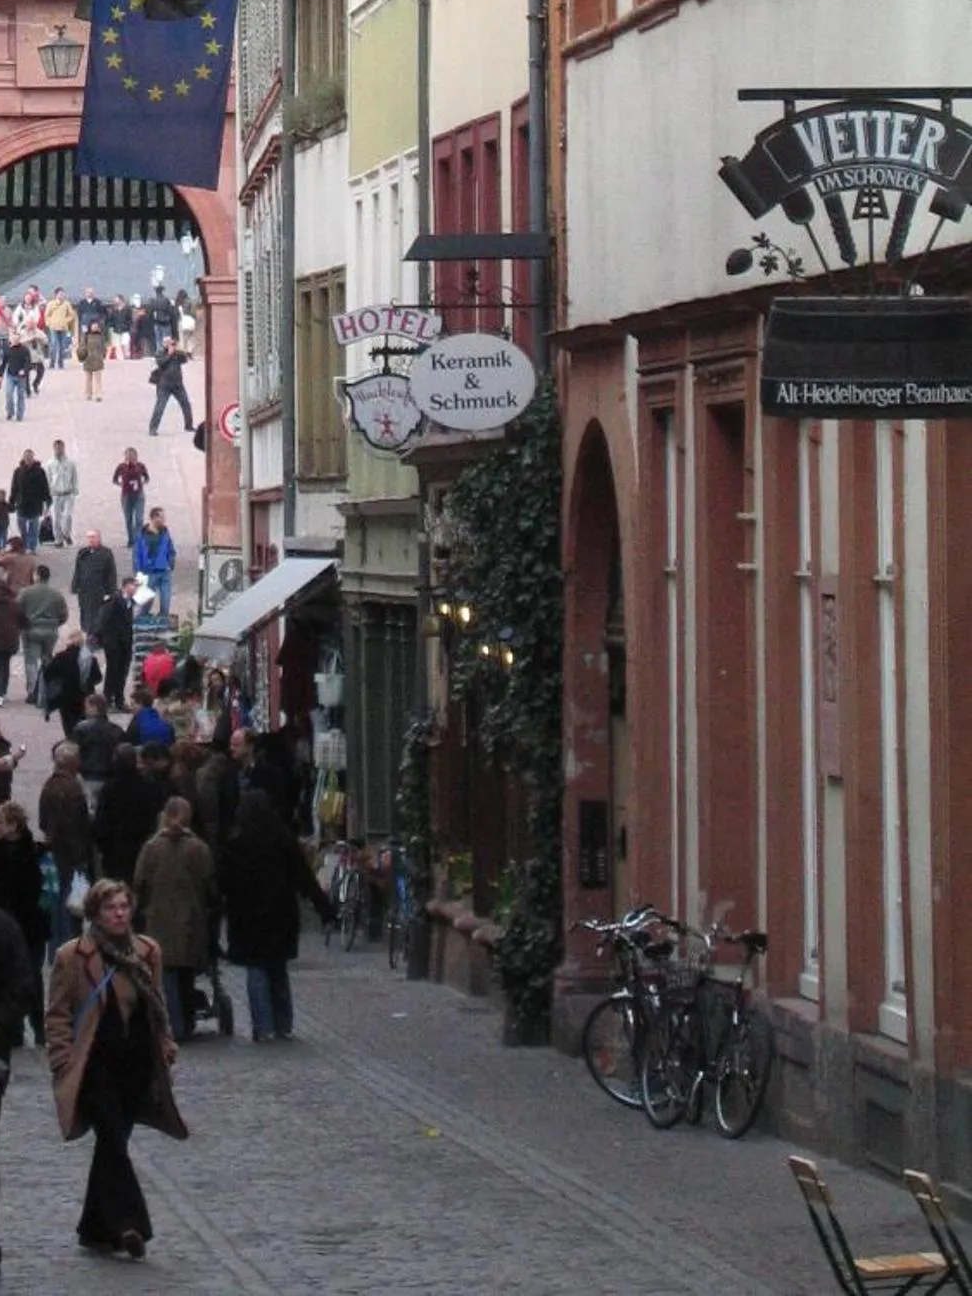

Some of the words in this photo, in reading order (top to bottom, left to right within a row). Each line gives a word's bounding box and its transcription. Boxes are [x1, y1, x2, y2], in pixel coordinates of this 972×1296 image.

[792, 110, 945, 171] VETTER
[815, 172, 842, 192] IM
[338, 308, 435, 340] HOTEL
[431, 351, 512, 371] Keramik
[464, 372, 481, 390] &
[430, 391, 518, 411] Schmuck
